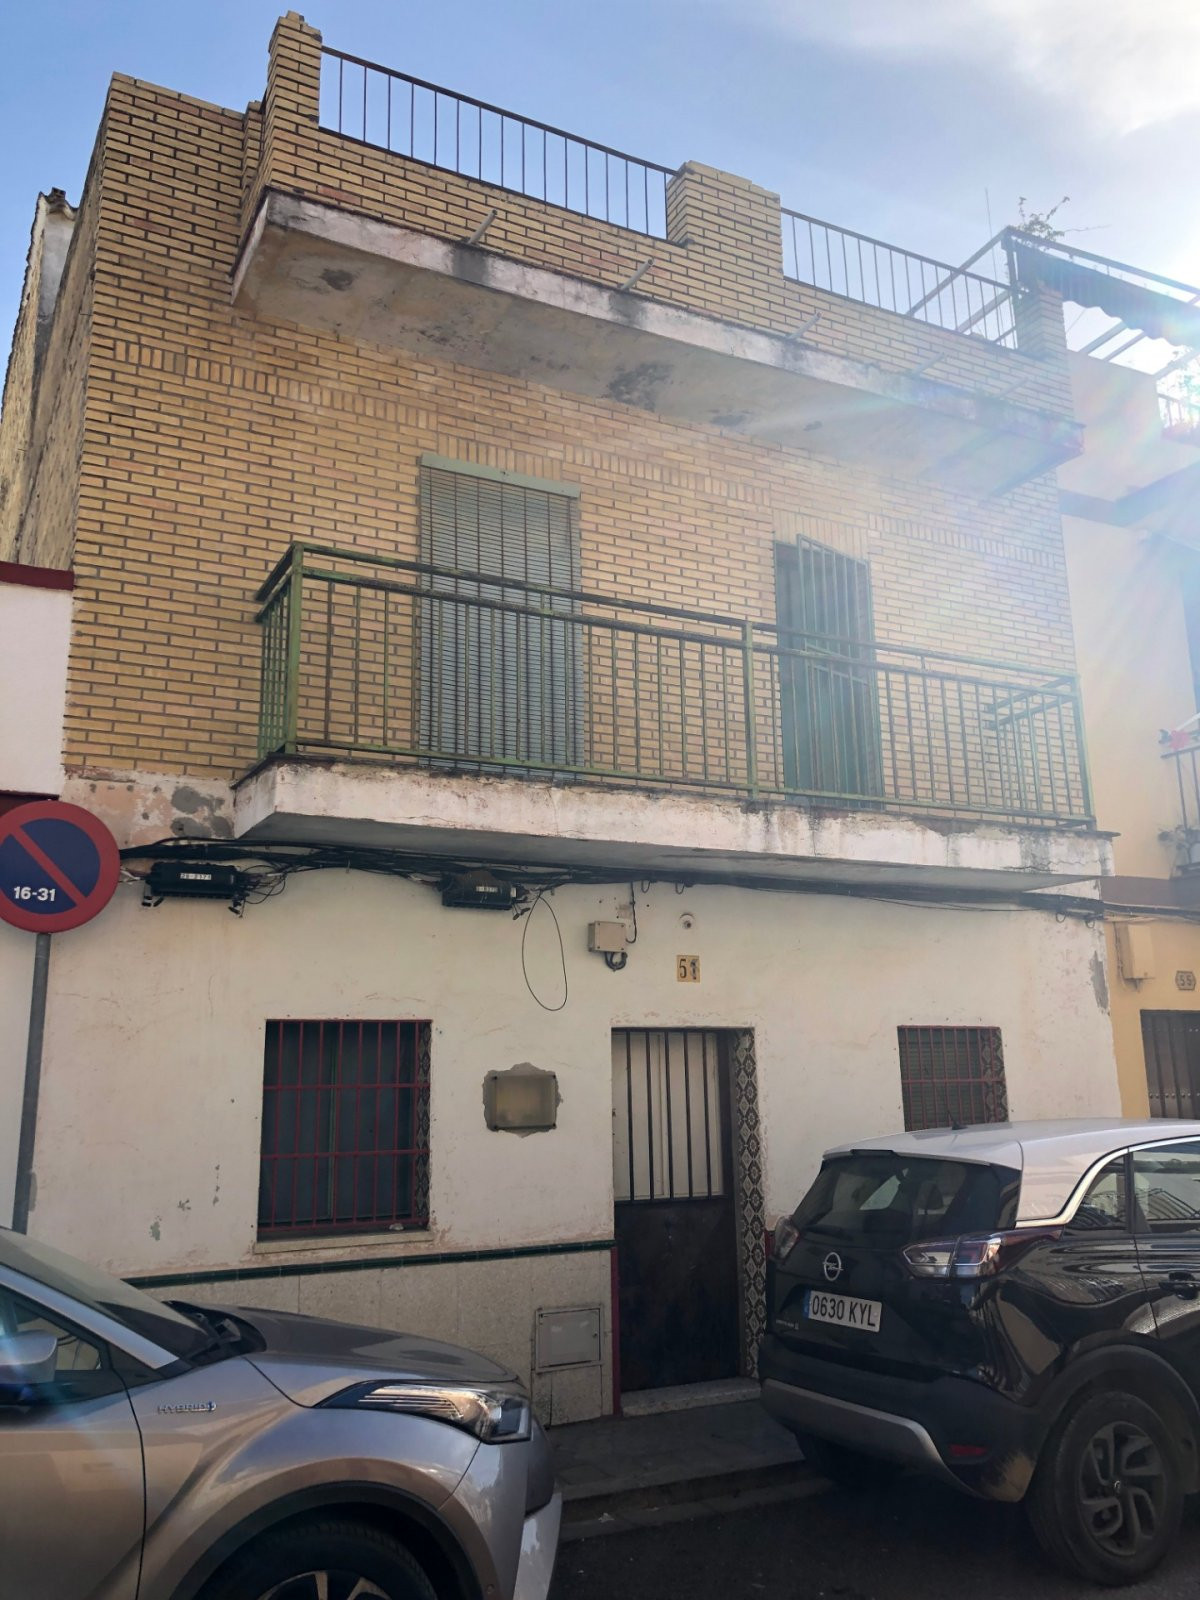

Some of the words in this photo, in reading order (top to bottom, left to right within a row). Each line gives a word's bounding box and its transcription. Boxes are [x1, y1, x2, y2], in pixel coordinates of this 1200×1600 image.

[13, 886, 56, 902] 16-31
[812, 1295, 845, 1320] 0630
[849, 1301, 876, 1327] KYL
